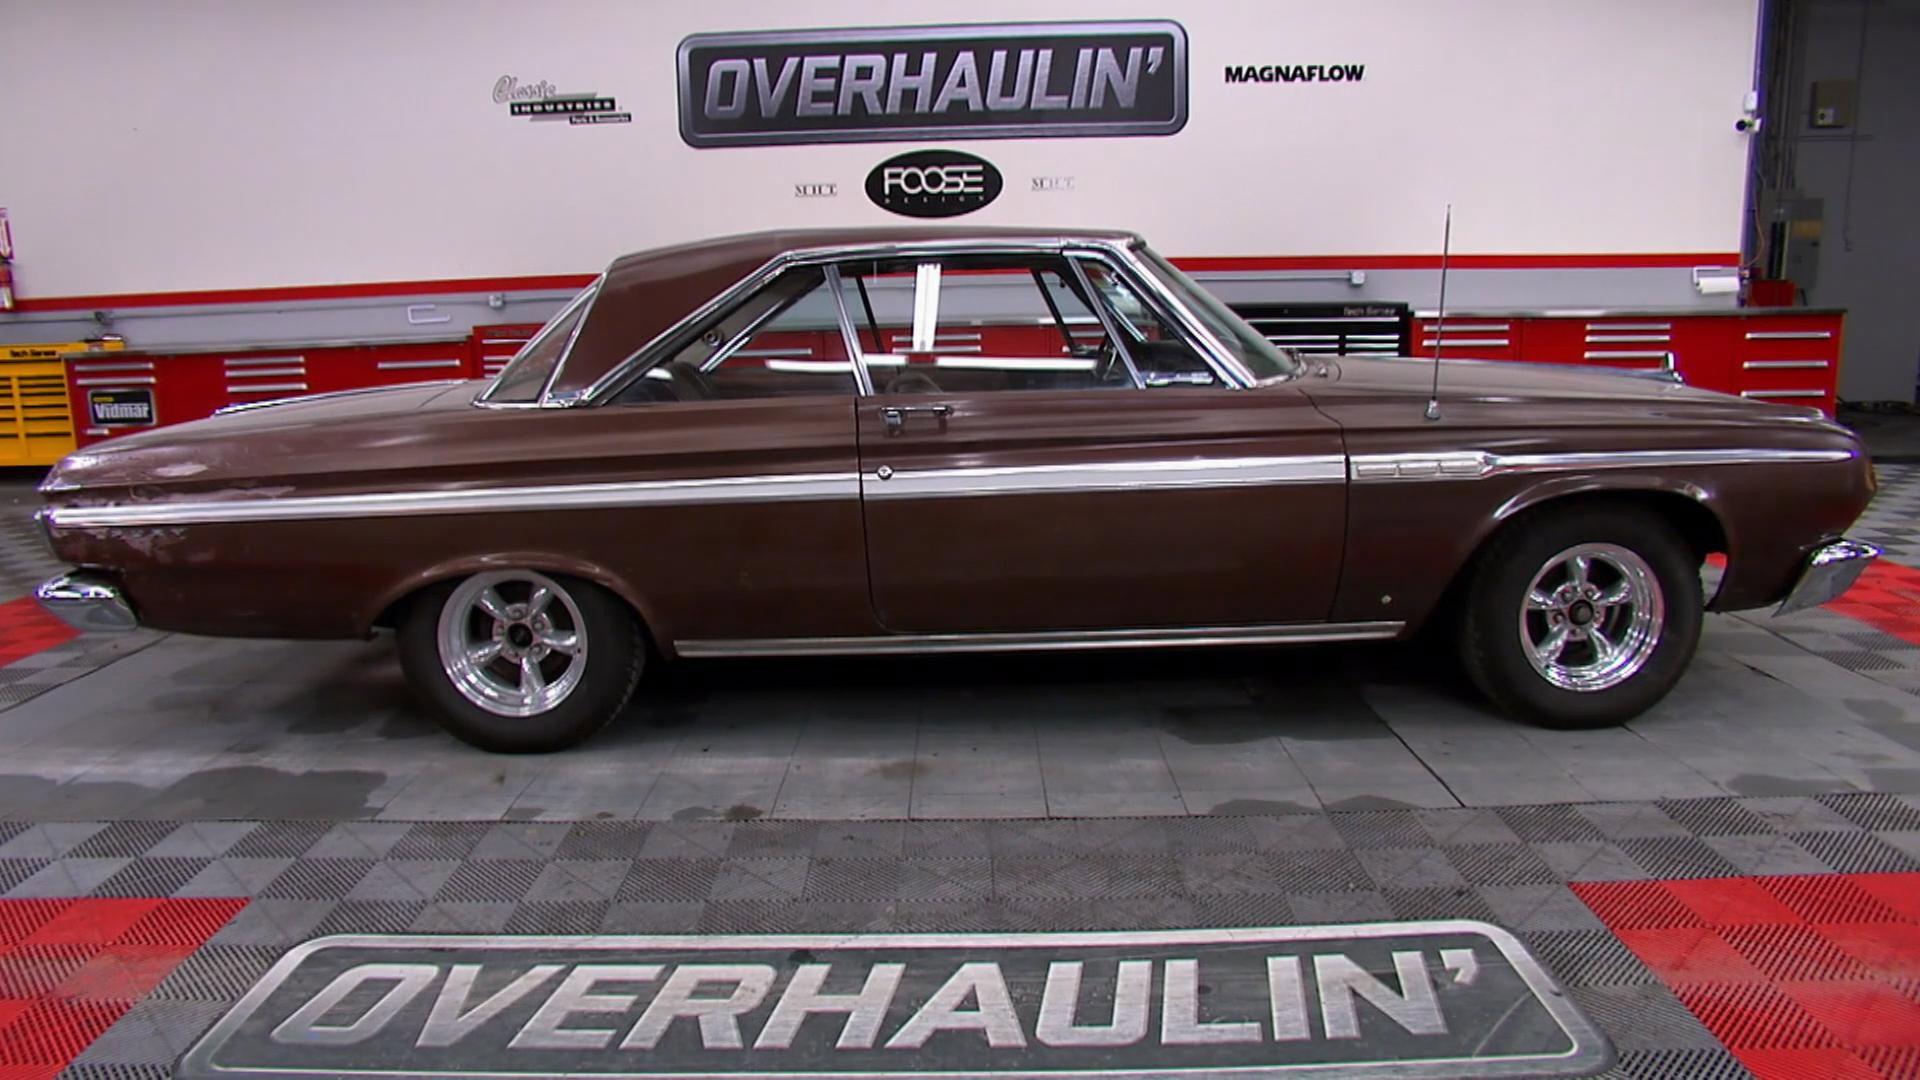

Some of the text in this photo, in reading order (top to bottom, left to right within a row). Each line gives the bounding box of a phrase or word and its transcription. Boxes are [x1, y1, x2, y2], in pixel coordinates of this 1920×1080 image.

[704, 46, 1164, 119] OVERHAULIN'
[1225, 65, 1365, 83] MAGNAFLOW
[492, 75, 557, 104] Classic
[884, 164, 983, 195] FOOSE
[884, 195, 984, 204] DESIGN
[94, 403, 149, 419] Vidmar
[270, 949, 1480, 1049] OVERHAULIN'
